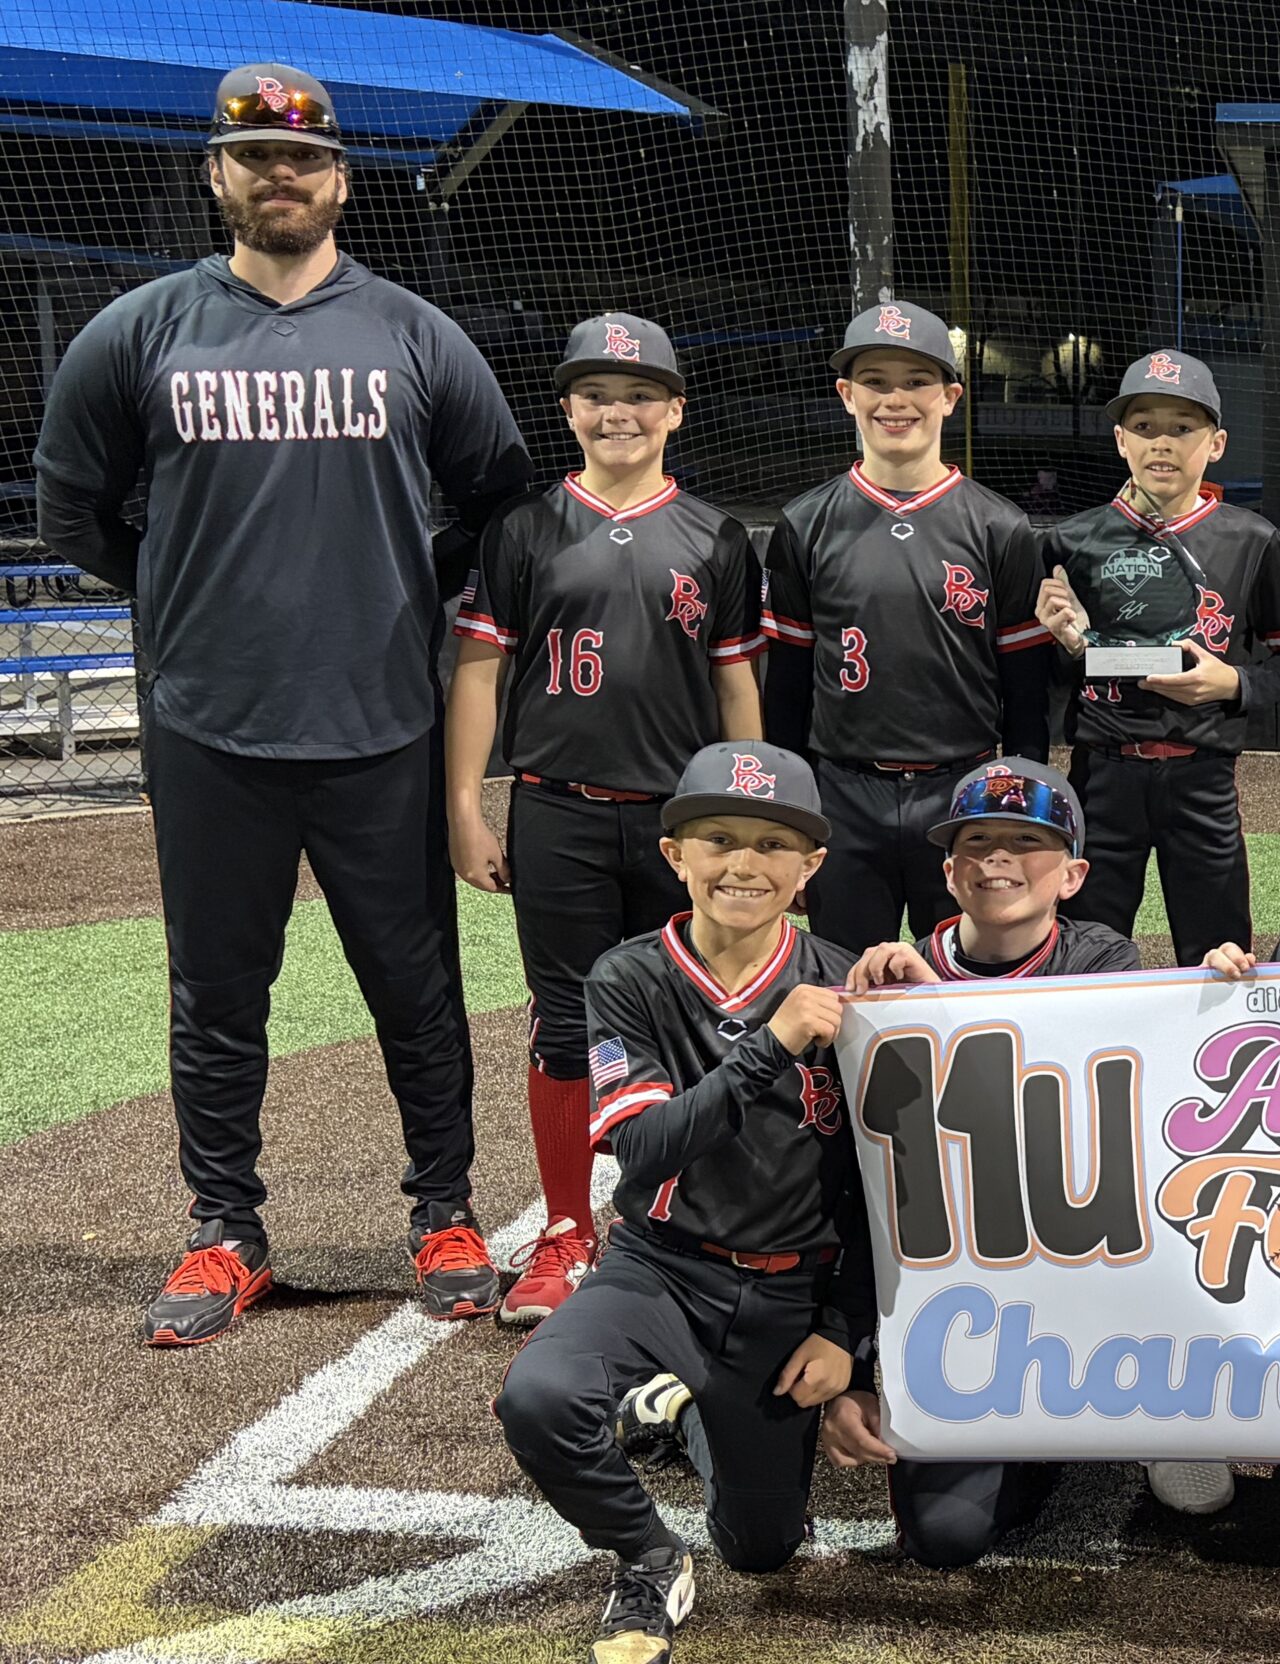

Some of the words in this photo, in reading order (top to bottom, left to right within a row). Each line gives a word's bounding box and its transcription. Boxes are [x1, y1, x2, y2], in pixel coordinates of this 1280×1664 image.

[171, 368, 387, 443] GENERALS
[1103, 563, 1160, 576] NATION
[546, 627, 604, 697] 16
[839, 627, 870, 693] 3
